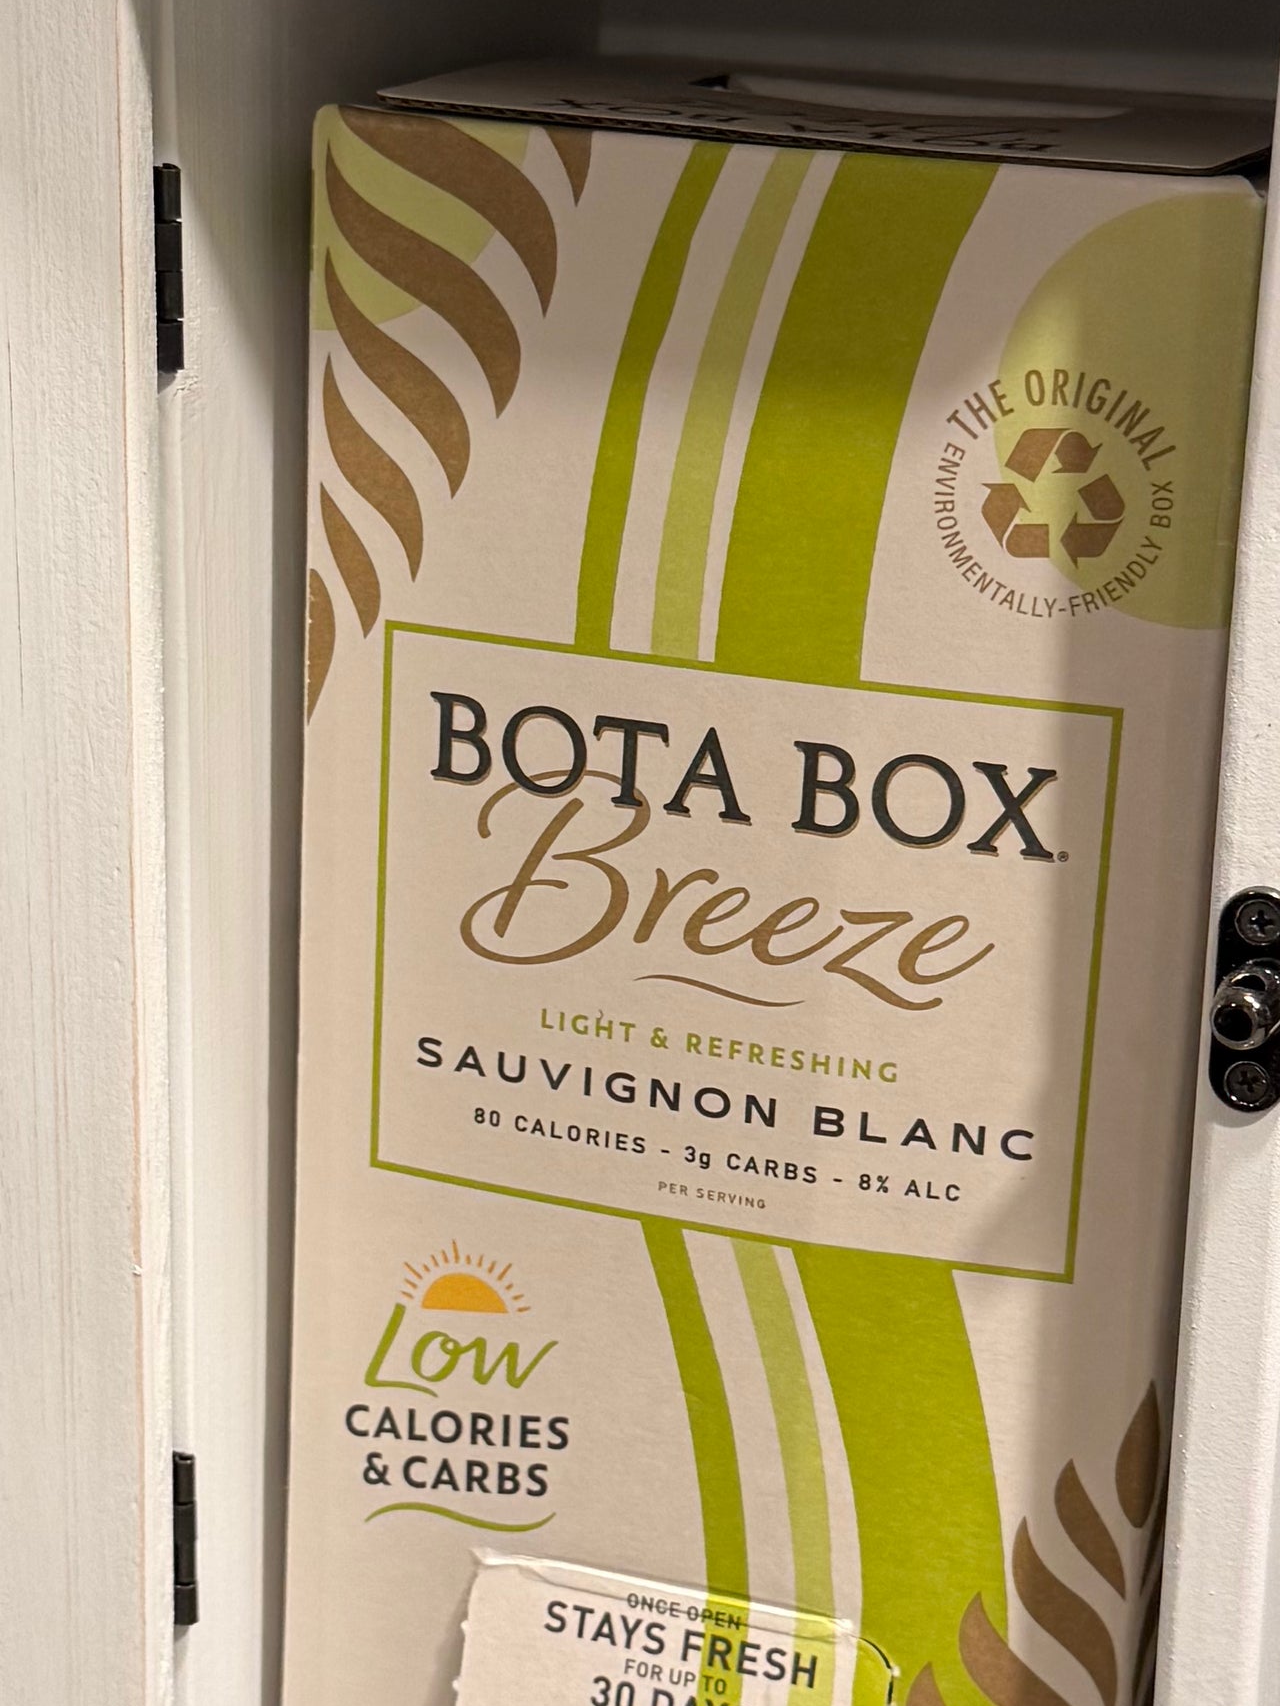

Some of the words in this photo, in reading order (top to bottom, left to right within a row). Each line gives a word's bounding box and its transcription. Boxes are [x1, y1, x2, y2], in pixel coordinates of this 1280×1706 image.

[946, 379, 1015, 440] THE
[1024, 368, 1176, 471] ORIGINAL
[934, 442, 1163, 618] ENVIRONMENTALLY-FRIENDLY
[1150, 480, 1174, 529] BOX
[429, 690, 752, 826] BOTA
[790, 739, 1058, 863] BOX
[459, 769, 995, 1012] Breeze
[540, 1008, 636, 1043] LIGHT
[649, 1026, 669, 1049] &
[685, 1032, 898, 1083] REFRESHING
[416, 1036, 777, 1128] SAUVIGNON
[813, 1104, 1035, 1161] BLANC
[473, 1107, 501, 1127] 80
[514, 1115, 646, 1154] CALORIES
[684, 1145, 711, 1170] 3g
[726, 1152, 818, 1184] CARBS
[858, 1173, 889, 1194] 8%
[904, 1179, 961, 1202] ALC
[657, 1180, 689, 1197] PER
[696, 1187, 767, 1210] SERVING
[364, 1302, 559, 1398] Low
[345, 1403, 570, 1450] CALORIES
[362, 1451, 392, 1486] &
[402, 1455, 549, 1497] CARBS
[543, 1600, 667, 1655] STAYS
[680, 1629, 818, 1689] FRESH
[626, 1593, 681, 1617] ONCE
[686, 1606, 741, 1631] OPEN
[623, 1658, 663, 1681] FOR
[669, 1668, 696, 1687] UP
[701, 1675, 728, 1695] TO
